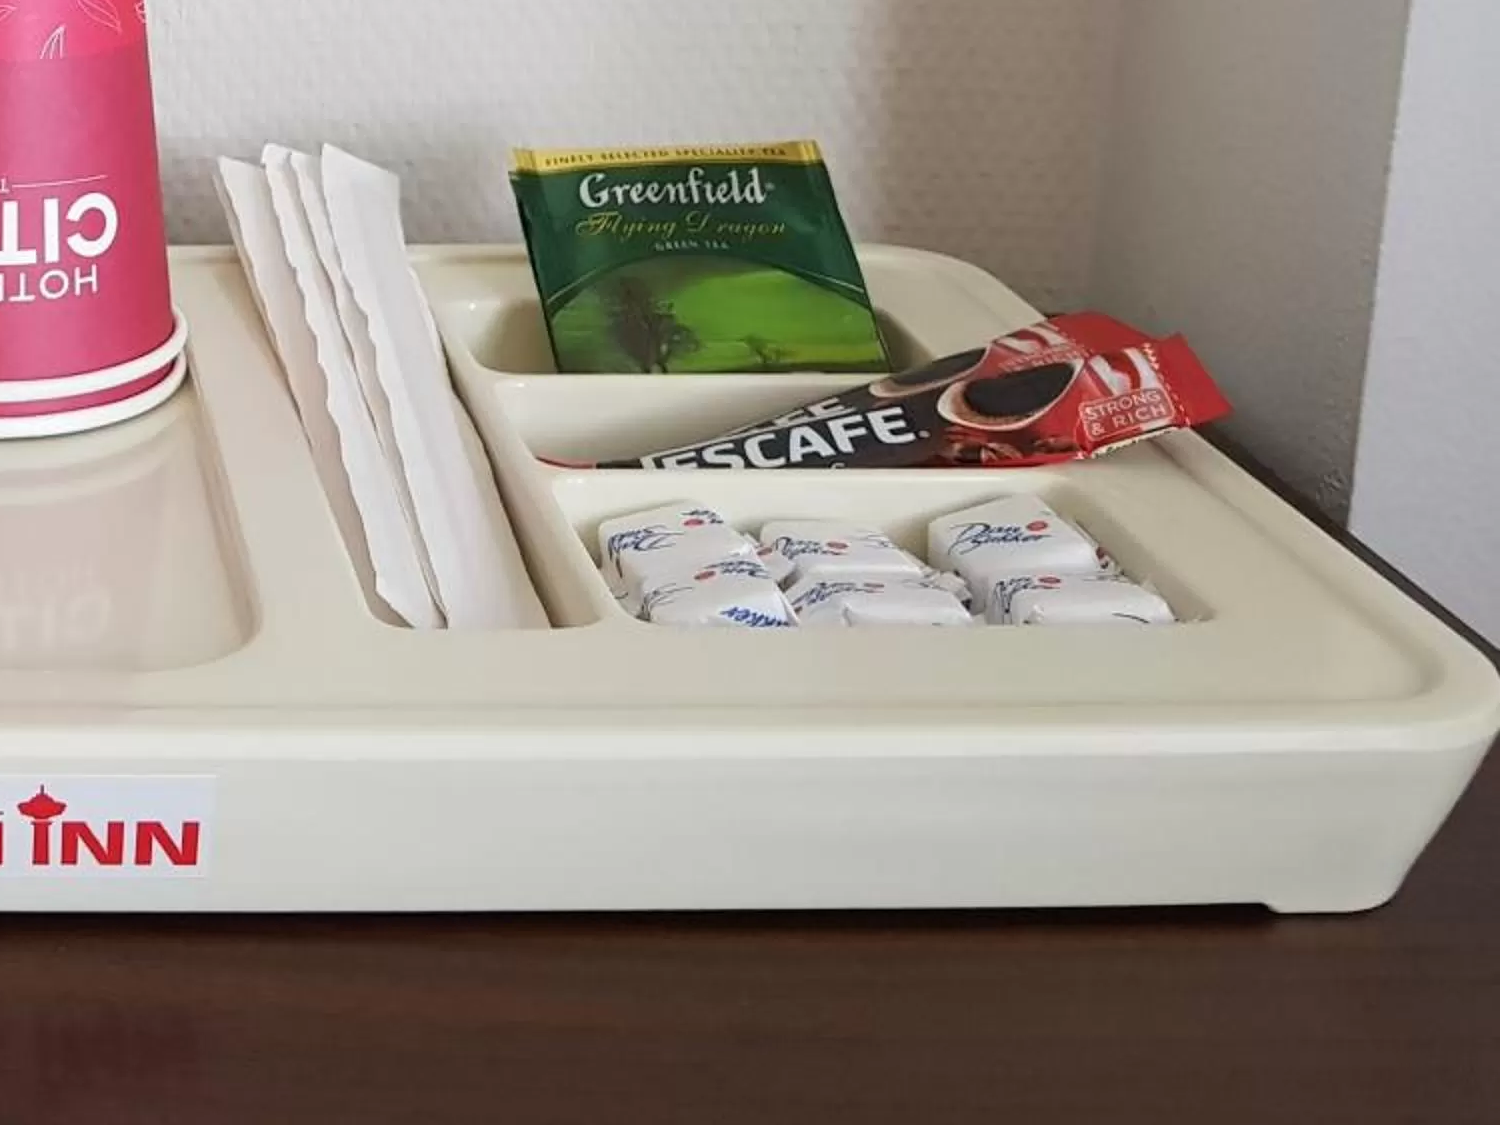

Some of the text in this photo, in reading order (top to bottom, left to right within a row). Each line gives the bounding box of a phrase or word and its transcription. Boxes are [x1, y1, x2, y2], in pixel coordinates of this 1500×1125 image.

[600, 150, 670, 161] SELECTED
[762, 146, 787, 156] TEA
[579, 167, 767, 208] Greenfield
[575, 210, 787, 242] Flying Dragon
[654, 239, 730, 252] GREEN TEA
[1085, 389, 1161, 421] STRONG
[1091, 406, 1167, 437] & RICH
[30, 820, 200, 865] INN
